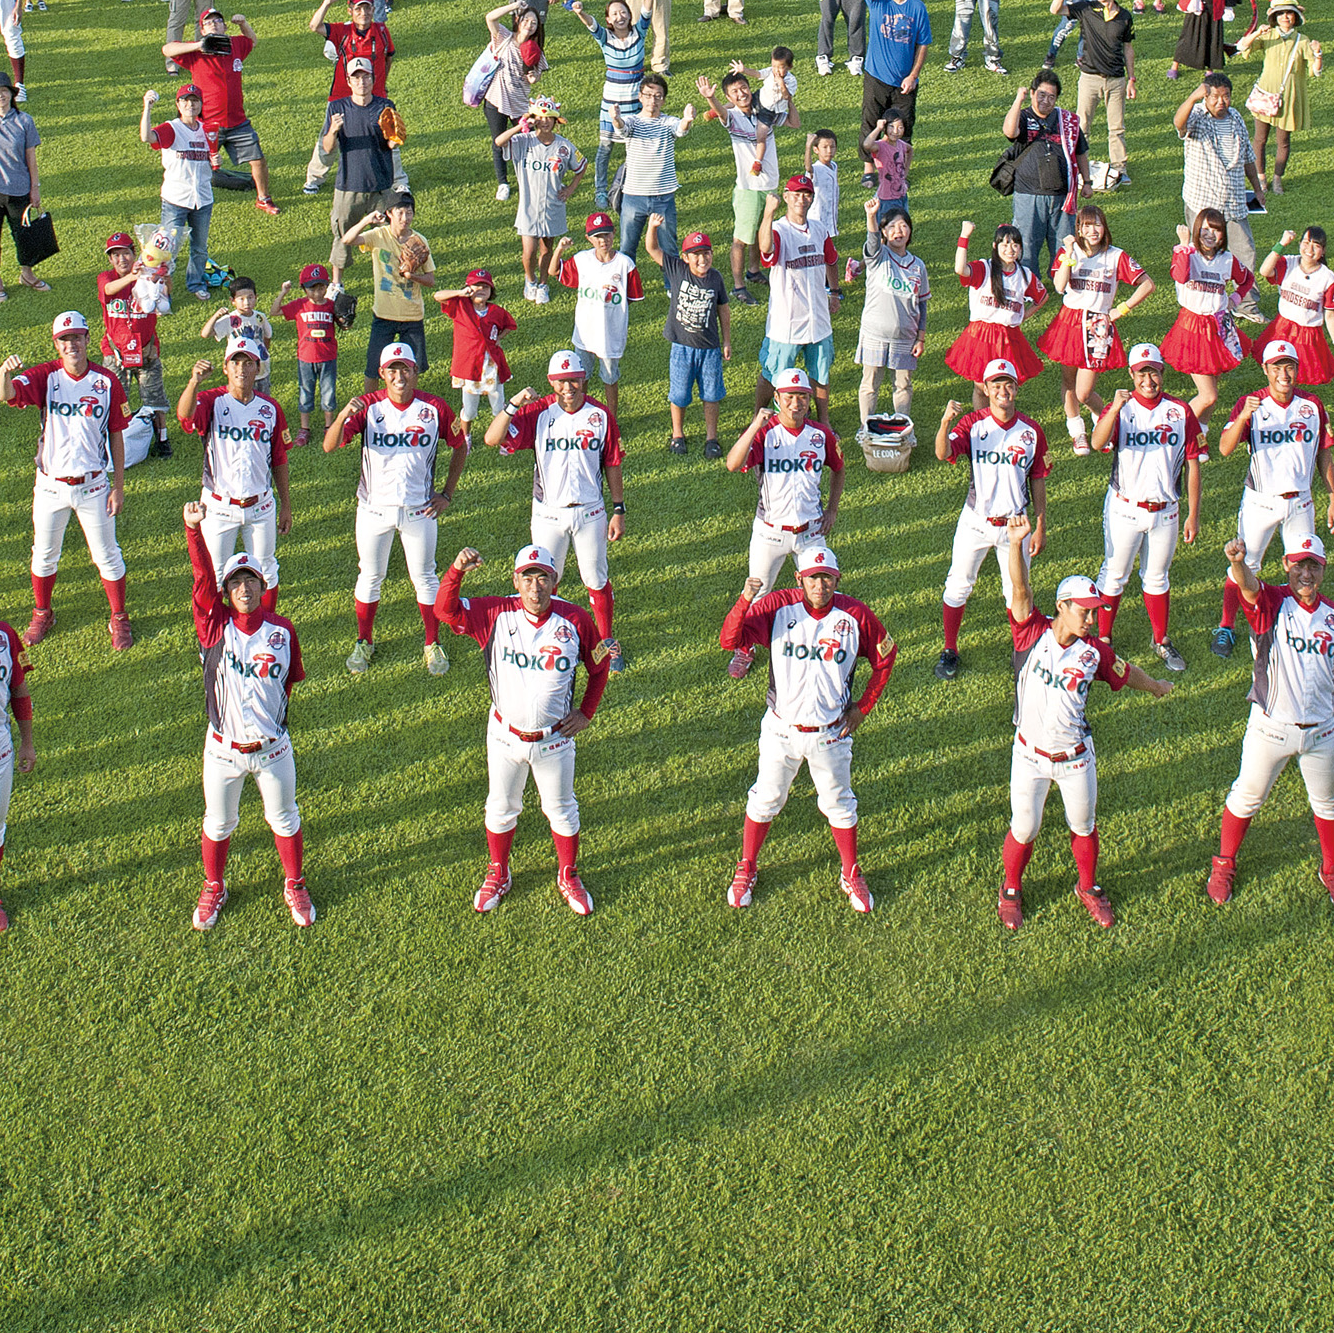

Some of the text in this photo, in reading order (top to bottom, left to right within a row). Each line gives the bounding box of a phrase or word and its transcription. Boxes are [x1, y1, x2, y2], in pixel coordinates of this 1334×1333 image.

[300, 311, 333, 323] VENICE
[50, 396, 103, 419] HOKTO
[218, 420, 269, 443] HOKTO
[372, 426, 430, 447] HOKTO
[545, 430, 600, 452] HOKTO
[1126, 424, 1178, 446] HOKTO
[1260, 422, 1313, 445] HOKTO
[768, 451, 822, 475] HOKTO
[976, 446, 1027, 468] HOKTO
[503, 646, 571, 672] HOKTO
[783, 638, 846, 665] HOKTO
[1032, 660, 1089, 693] HOKTO
